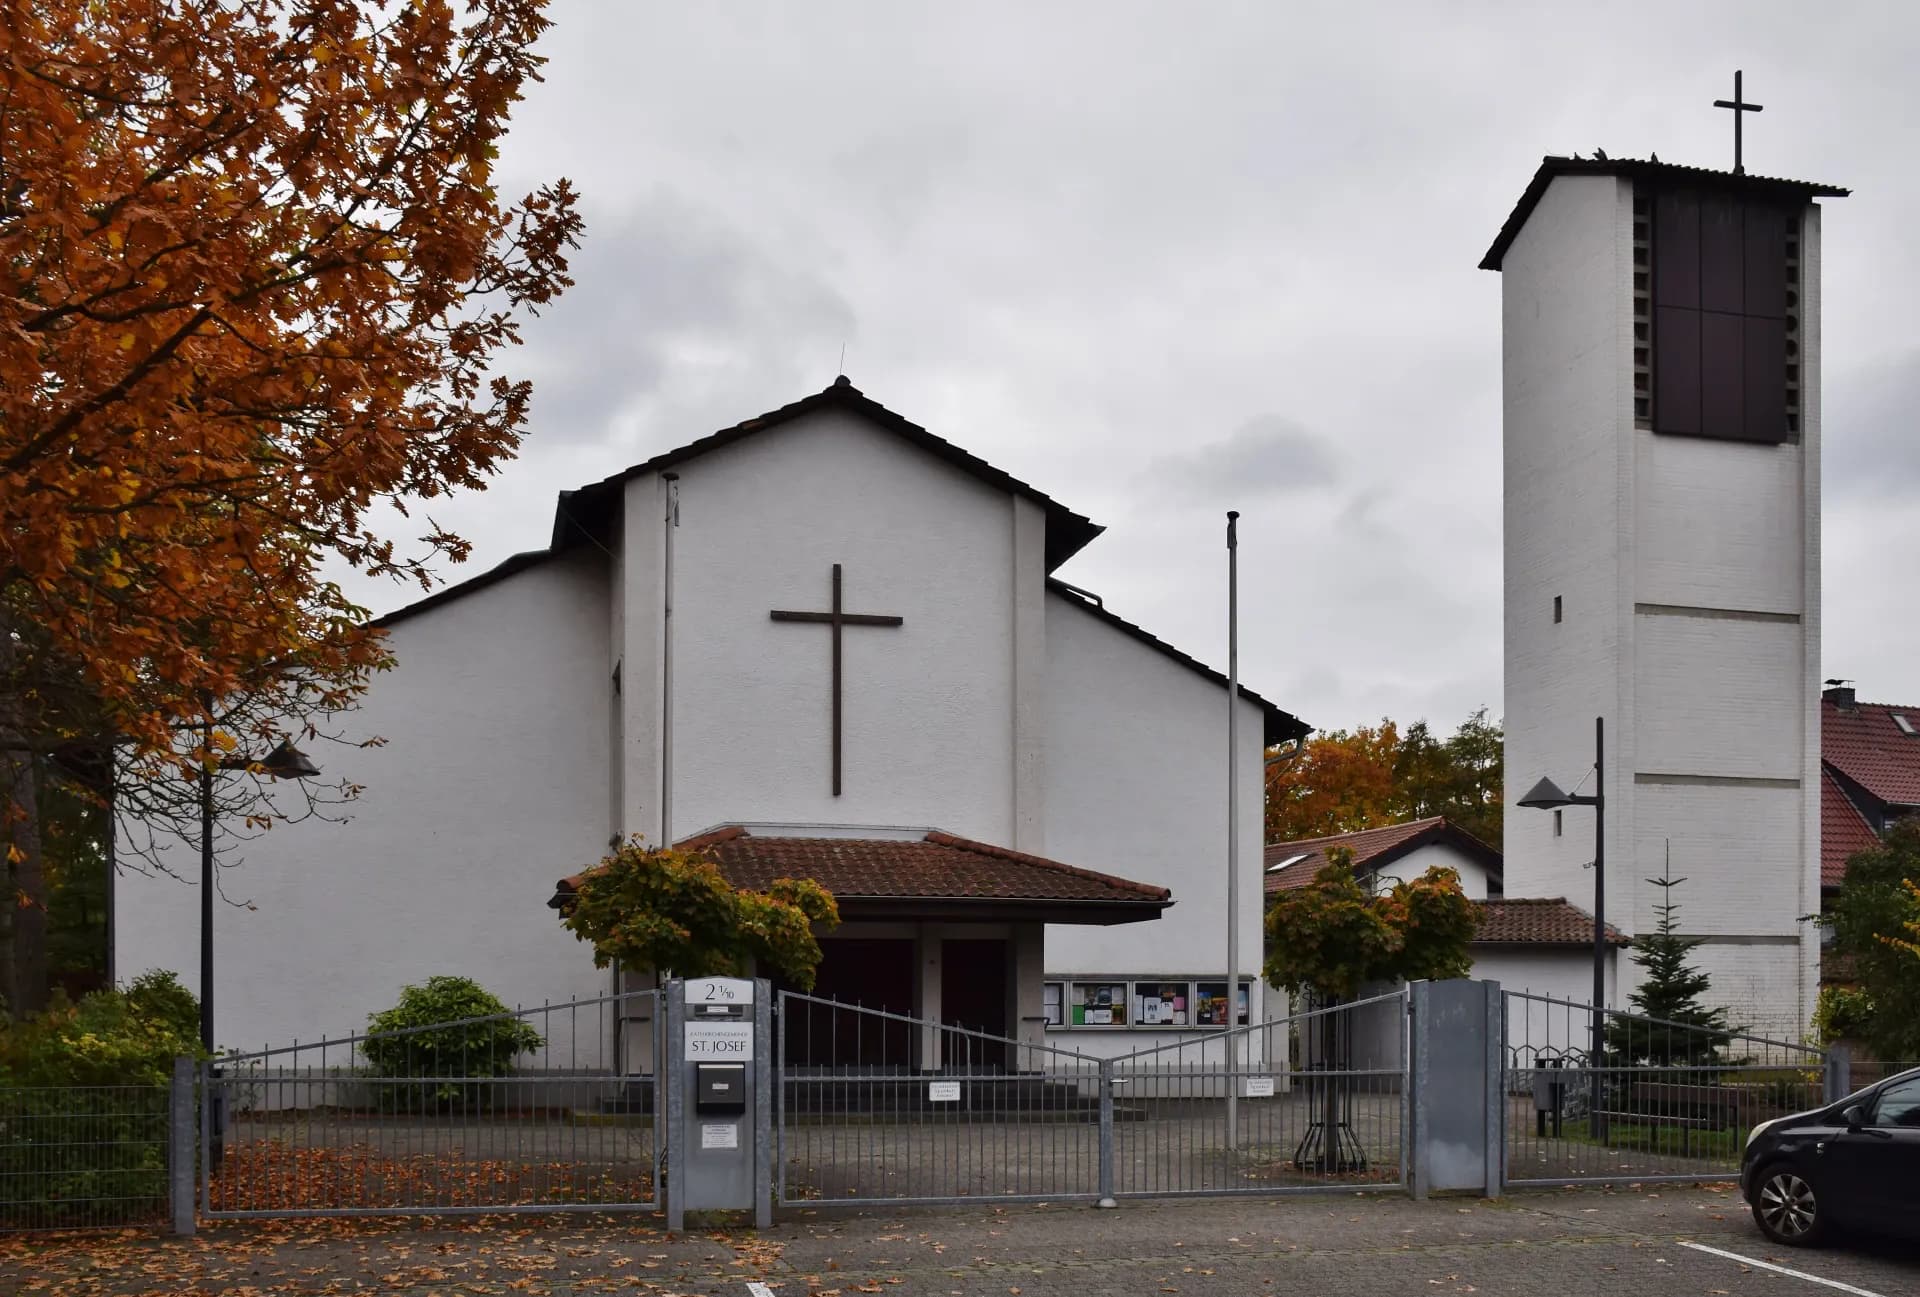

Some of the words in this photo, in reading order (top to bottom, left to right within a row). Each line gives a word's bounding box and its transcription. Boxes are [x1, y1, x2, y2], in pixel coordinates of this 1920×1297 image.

[705, 983, 716, 1000] 2
[692, 1040, 710, 1052] ST.
[712, 1040, 747, 1053] JOSEF
